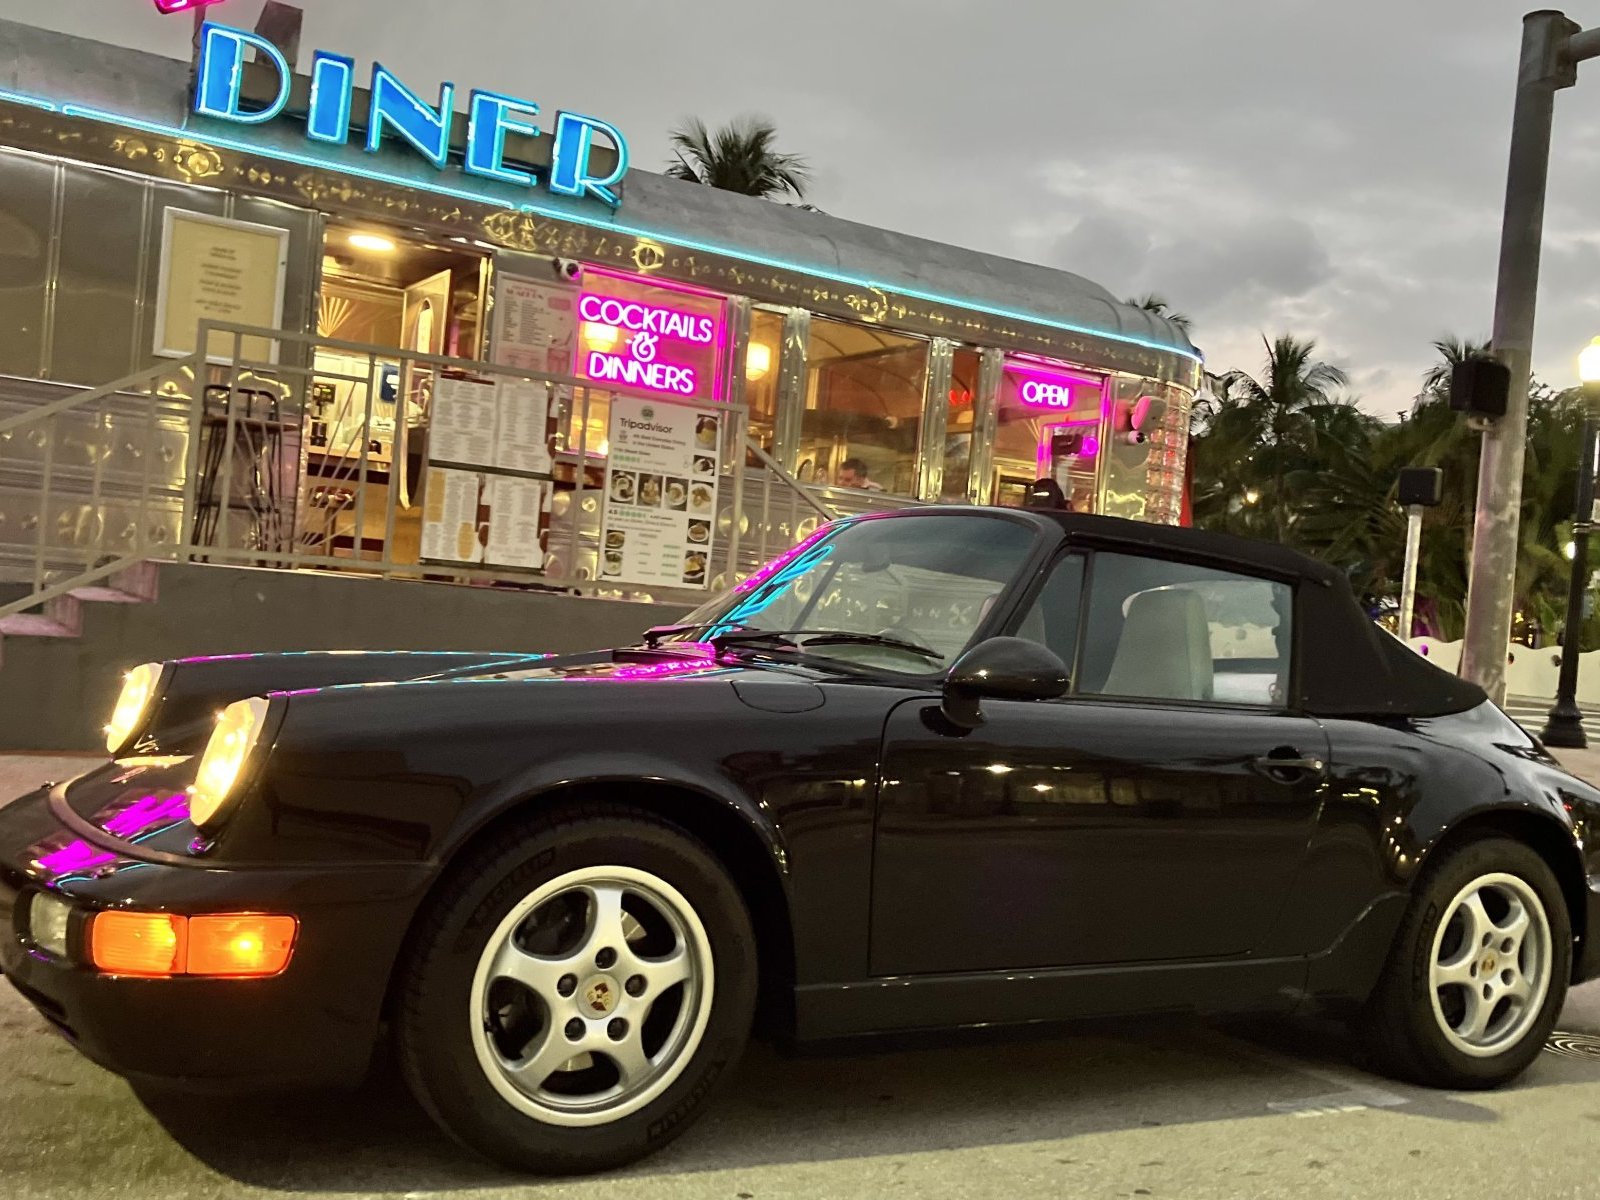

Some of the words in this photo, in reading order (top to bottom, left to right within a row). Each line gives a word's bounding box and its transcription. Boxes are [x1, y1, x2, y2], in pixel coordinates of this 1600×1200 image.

[194, 20, 629, 208] DINER
[578, 295, 713, 343] COCKTAILS
[625, 331, 659, 363] &
[588, 351, 695, 394] DINNERS
[1022, 380, 1070, 407] OPEN
[620, 417, 673, 434] Tripadvisor
